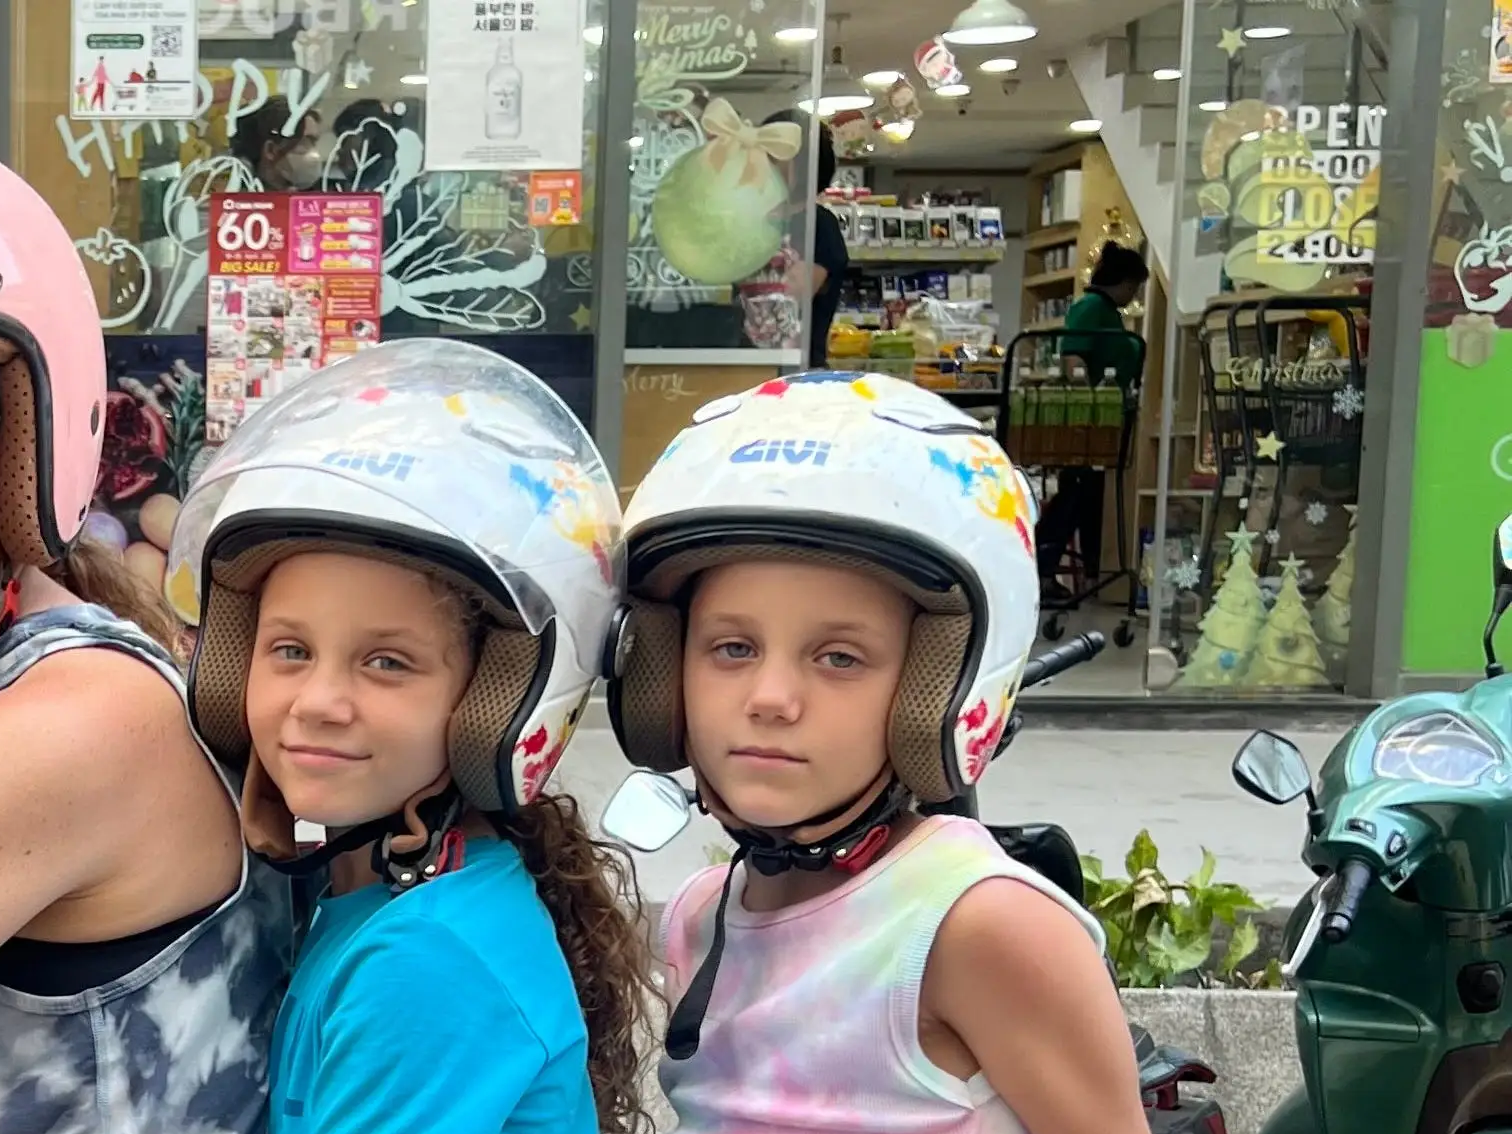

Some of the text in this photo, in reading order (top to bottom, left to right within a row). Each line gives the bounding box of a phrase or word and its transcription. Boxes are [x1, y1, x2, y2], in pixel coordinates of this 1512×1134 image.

[474, 2, 516, 16] 풍부한
[473, 18, 516, 31] 서울의
[1259, 186, 1378, 228] CLOSE
[220, 261, 243, 273] BIG
[1226, 356, 1345, 388] Christmas
[321, 448, 416, 482] GIVI
[729, 439, 832, 467] GIVI
